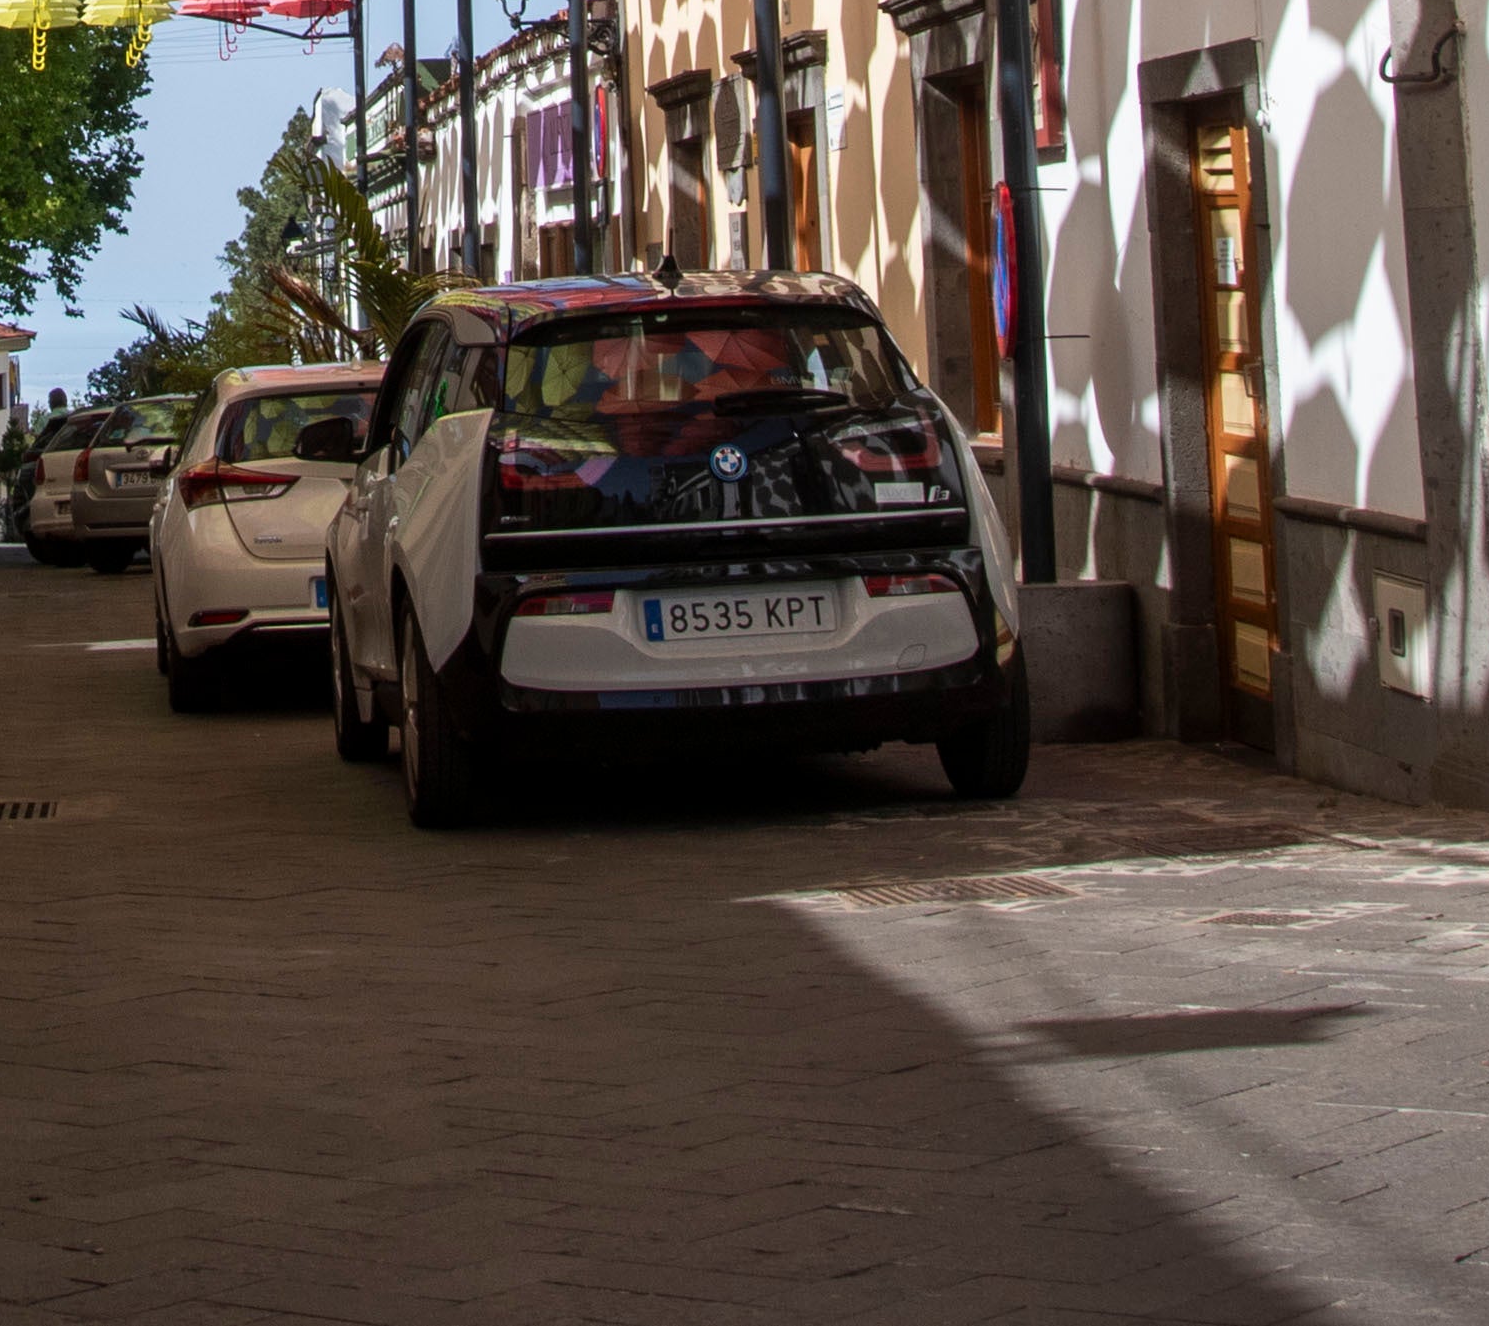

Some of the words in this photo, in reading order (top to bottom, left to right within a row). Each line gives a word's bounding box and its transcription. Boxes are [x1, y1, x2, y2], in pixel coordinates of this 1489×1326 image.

[123, 472, 149, 485] 3479
[669, 600, 754, 633] 8535
[764, 596, 825, 628] KPT
